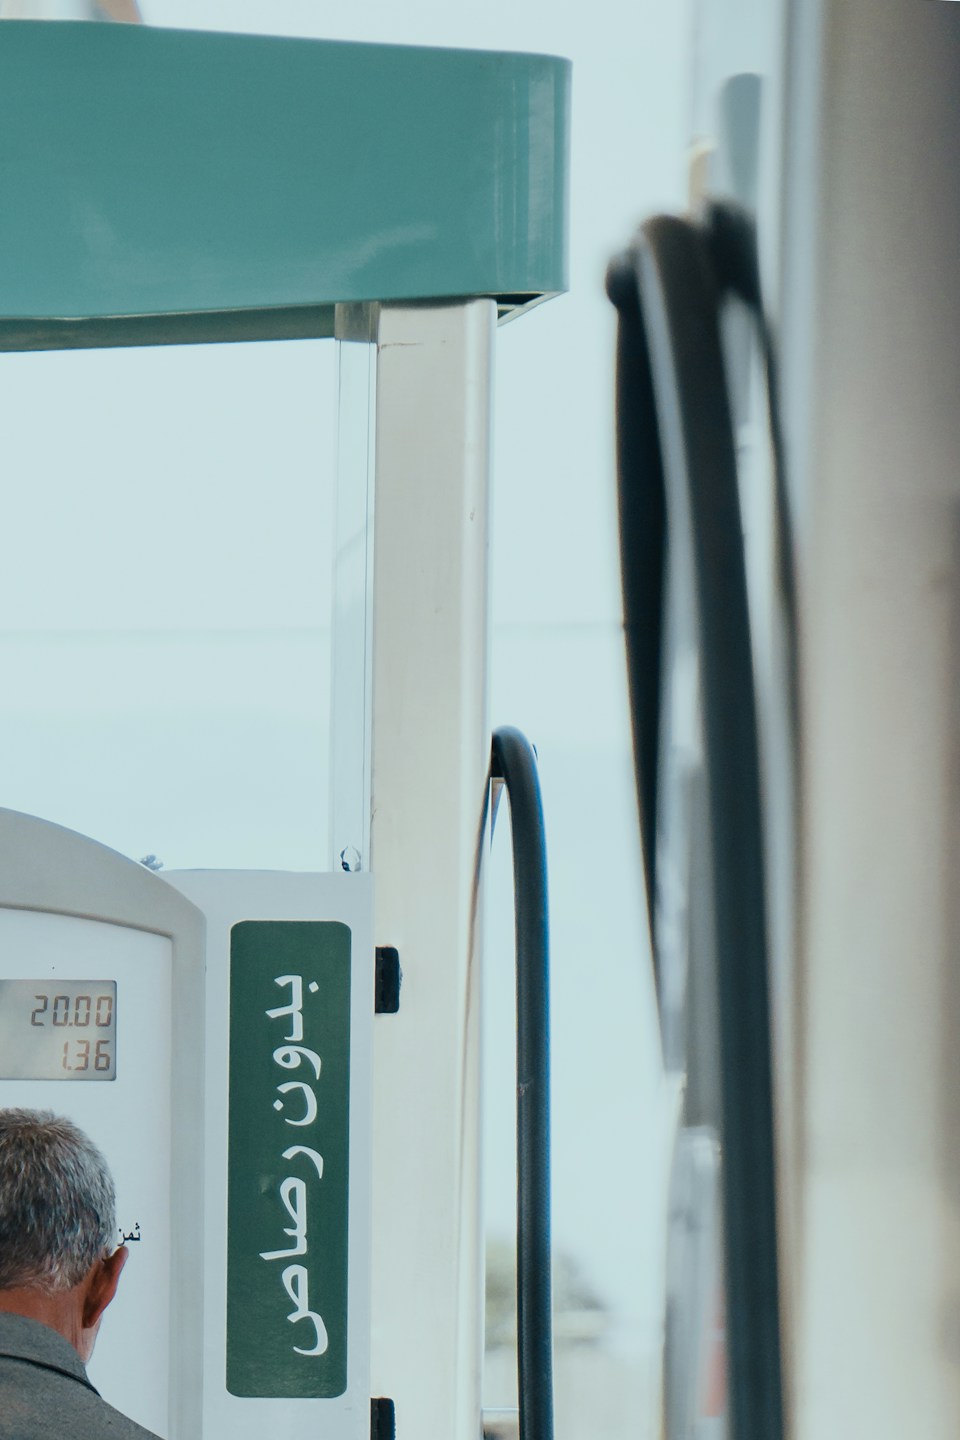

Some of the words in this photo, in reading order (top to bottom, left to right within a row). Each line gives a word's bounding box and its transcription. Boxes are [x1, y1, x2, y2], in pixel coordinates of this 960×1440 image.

[31, 995, 113, 1027] 20.00
[62, 1040, 111, 1071] 1.36
[266, 974, 321, 1127] بدون
[259, 1145, 328, 1356] رصاص
